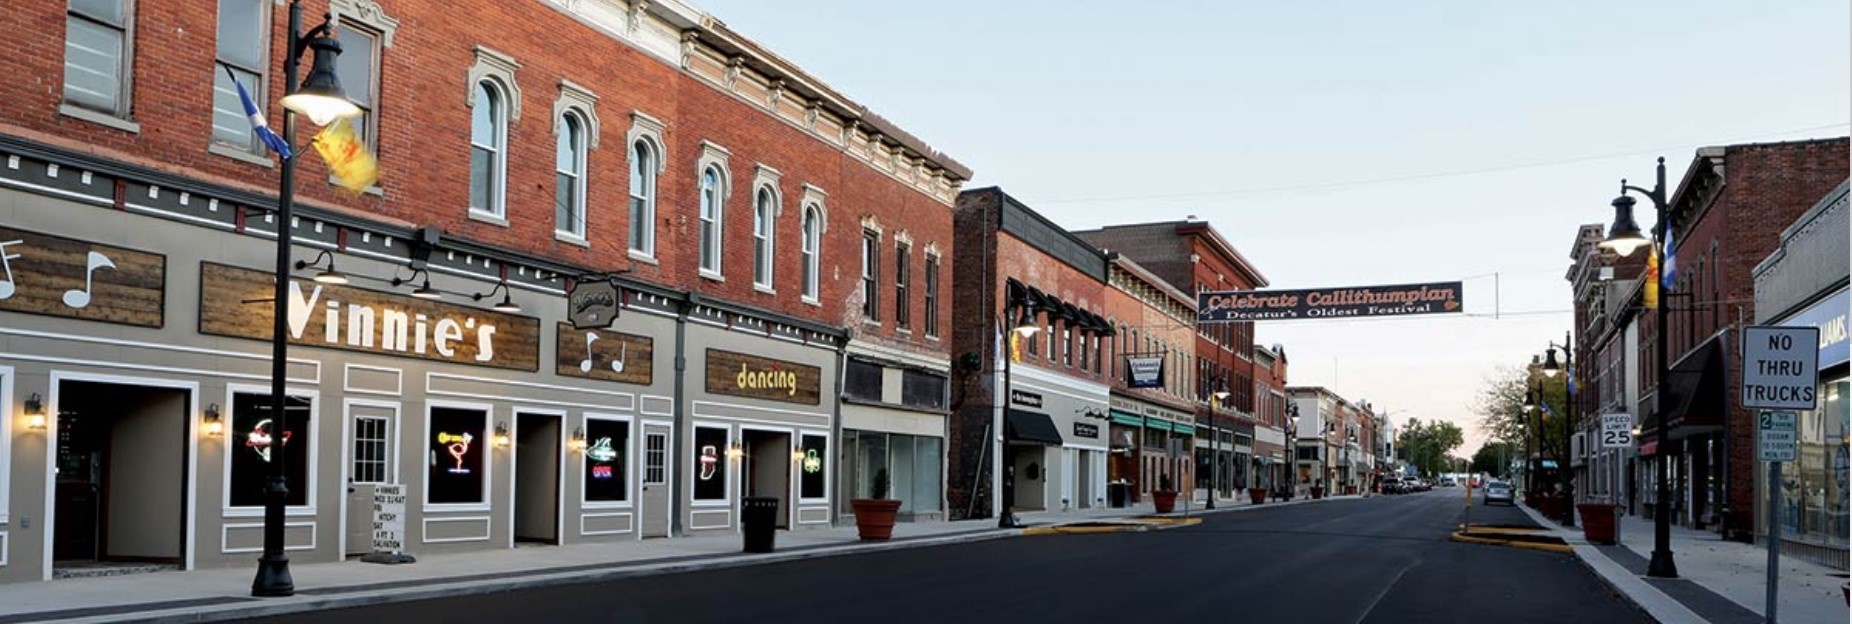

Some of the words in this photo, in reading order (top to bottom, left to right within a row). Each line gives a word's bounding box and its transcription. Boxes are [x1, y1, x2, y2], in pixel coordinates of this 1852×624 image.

[1208, 293, 1298, 309] Celebrate
[1306, 286, 1455, 307] Callithumpian
[1226, 310, 1298, 319] Decatur's
[1306, 307, 1359, 317] Oldest
[1368, 303, 1430, 315] Festival
[276, 278, 496, 362] Vinnie's
[1768, 334, 1792, 350] NO
[1757, 359, 1803, 376] THRU
[736, 362, 796, 396] dancing
[1745, 384, 1814, 402] TRUCKS
[1761, 413, 1770, 428] 2
[1604, 430, 1630, 444] 25
